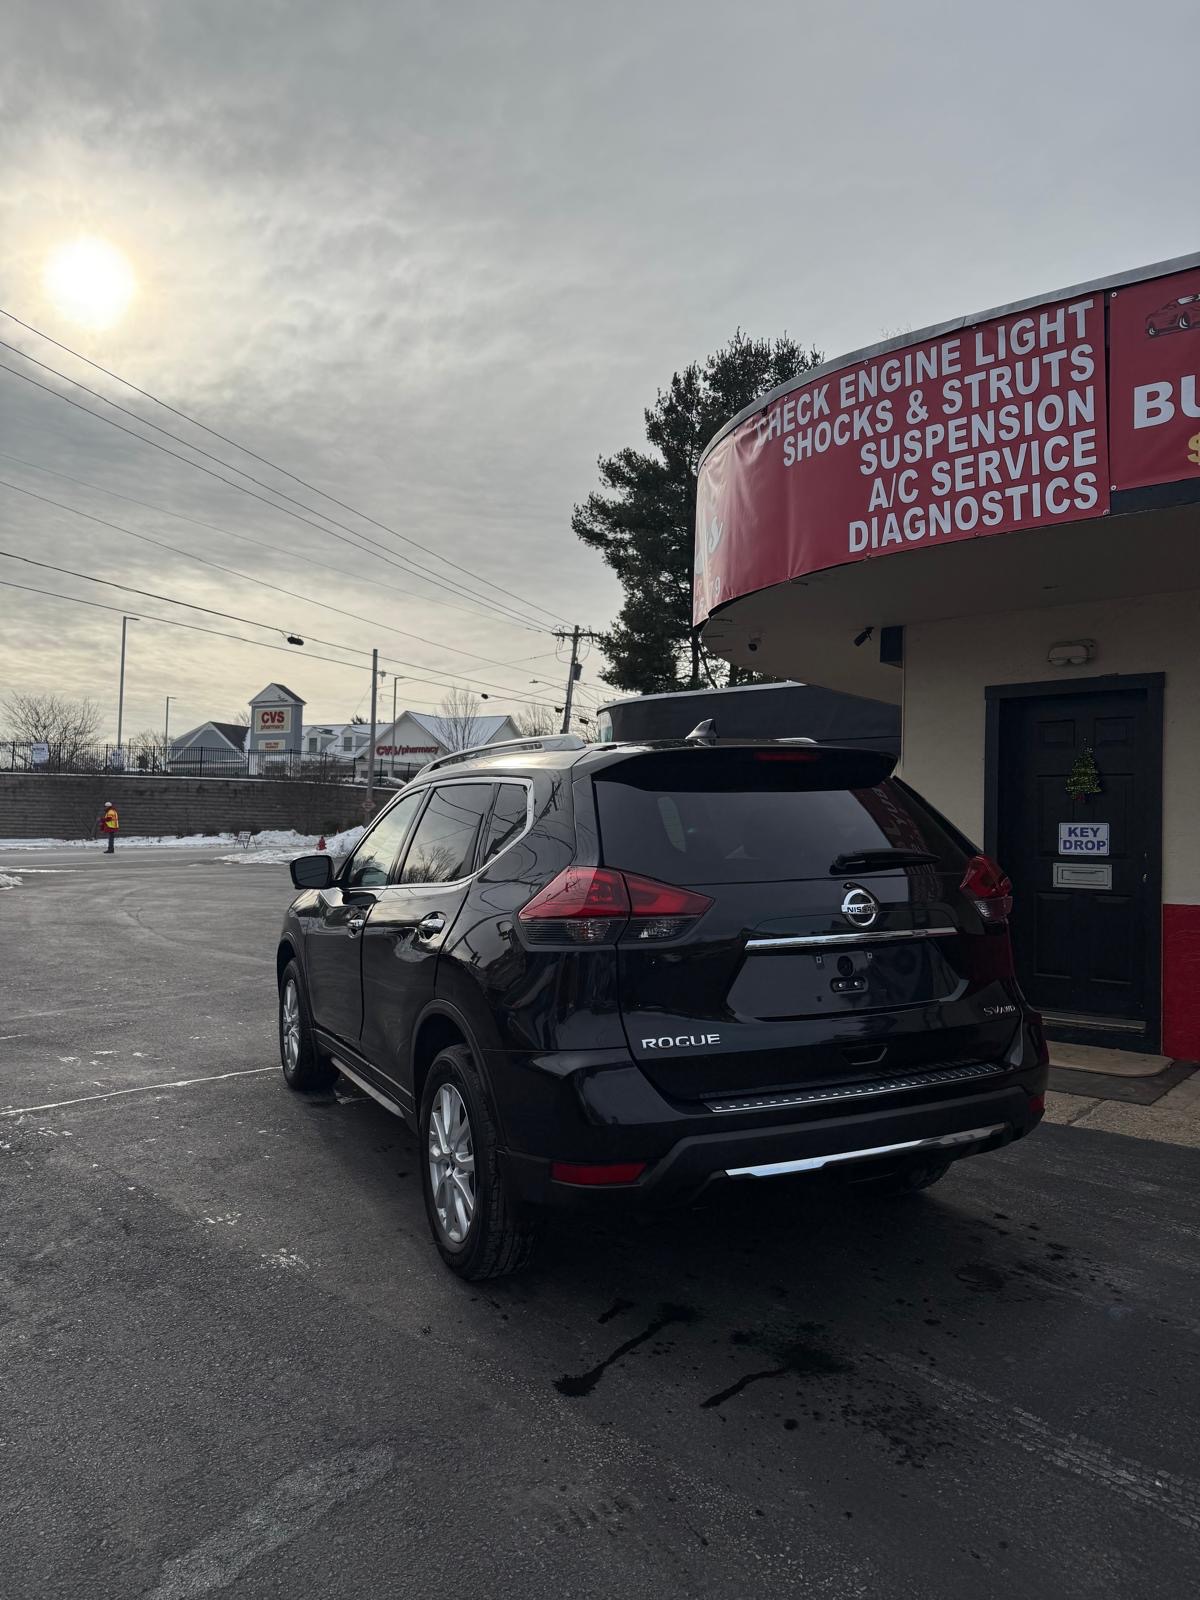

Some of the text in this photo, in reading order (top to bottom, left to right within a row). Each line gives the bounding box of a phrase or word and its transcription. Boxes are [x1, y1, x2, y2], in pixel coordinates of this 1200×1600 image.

[756, 299, 1095, 442] CHECK ENGINE LIGHT
[783, 344, 1096, 467] SHOCKS & STRUTS
[859, 385, 1096, 476] SUSPENSION
[867, 428, 1098, 513] A/C SERVICE
[848, 471, 1099, 553] DIAGNOSTICS
[261, 711, 285, 724] CVS
[1062, 840, 1107, 852] DROP
[1068, 826, 1101, 838] KEY
[846, 905, 878, 914] NISSAN
[641, 1033, 721, 1049] ROGUE
